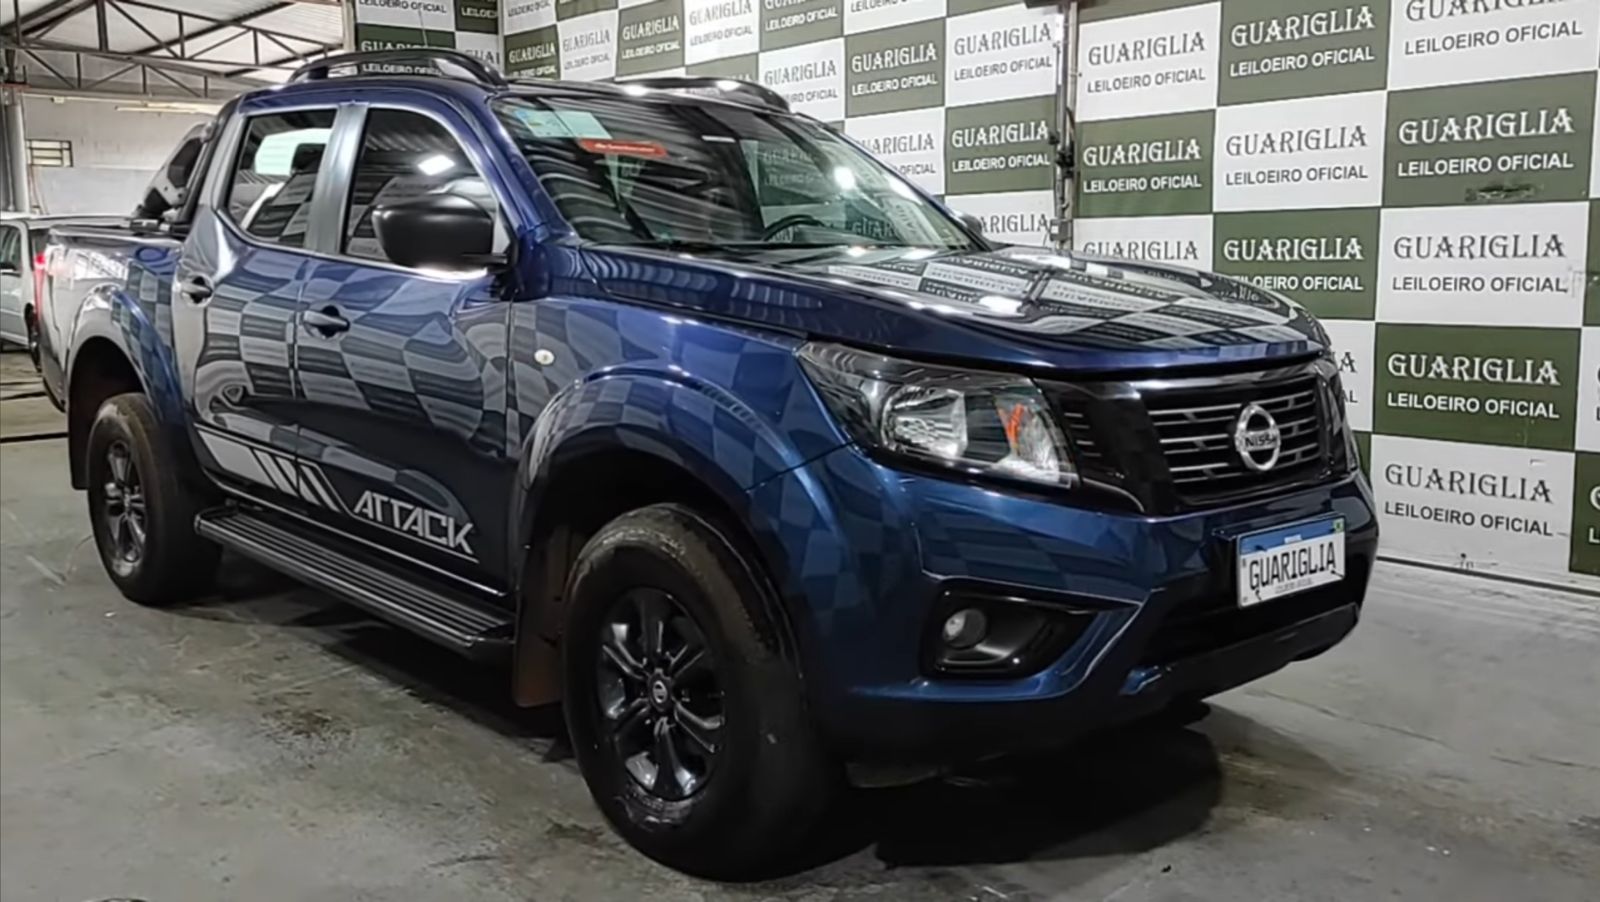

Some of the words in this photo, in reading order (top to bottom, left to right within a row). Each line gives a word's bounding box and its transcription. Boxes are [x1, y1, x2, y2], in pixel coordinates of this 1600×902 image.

[410, 1, 448, 13] OFICIAL
[689, 1, 752, 26] GUARIGLIA
[765, 14, 804, 32] LEILOEIRO
[806, 7, 838, 22] OFICIAL
[623, 15, 680, 41] GUARIGLIA
[690, 30, 723, 47] LEILOEIRO
[724, 26, 753, 39] OFICIAL
[954, 22, 1052, 56] GUARIGLIA
[1231, 5, 1376, 47] GUARIGLIA
[1405, 31, 1500, 55] LEILOEIRO
[1505, 20, 1583, 43] OFICIAL
[509, 43, 557, 64] GUARIGLIA
[563, 30, 611, 52] GUARIGLIA
[1088, 31, 1206, 66] GUARIGLIA
[852, 43, 938, 73] GUARIGLIA
[954, 62, 1008, 81] LEILOEIRO
[1010, 56, 1053, 74] OFICIAL
[1230, 54, 1308, 78] LEILOEIRO
[1311, 46, 1376, 68] OFICIAL
[764, 60, 837, 86] GUARIGLIA
[852, 78, 899, 97] LEILOEIRO
[901, 73, 938, 89] OFICIAL
[1087, 74, 1152, 94] LEILOEIRO
[1155, 68, 1207, 86] OFICIAL
[805, 88, 838, 102] OFICIAL
[952, 120, 1049, 148] GUARIGLIA
[1399, 107, 1576, 145] GUARIGLIA
[861, 132, 935, 155] UARIGLIA
[1083, 137, 1202, 168] GUARIGLIA
[1226, 125, 1369, 157] GUARIGLIA
[952, 156, 1006, 173] LEILOEIRO
[1008, 153, 1051, 169] OFICIAL
[1225, 169, 1302, 187] LEILOEIRO
[1306, 165, 1370, 182] OFICIAL
[1398, 157, 1493, 177] LEILOEIRO
[1497, 152, 1575, 172] OFICIAL
[1083, 177, 1148, 195] LEILOEIRO
[1150, 173, 1202, 191] OFICIAL
[1083, 240, 1200, 261] GUARIGLIA
[1223, 237, 1364, 261] GUARIGLIA
[1393, 234, 1567, 260] GUARIGLIA
[1302, 276, 1364, 292] OFICIAL
[1392, 277, 1485, 292] LEILOEIRO
[1490, 276, 1568, 293] OFICIAL
[1387, 353, 1561, 386] GUARIGLIA
[1387, 392, 1480, 413] LEILOEIRO
[1485, 398, 1560, 419] OFICIAL
[1385, 463, 1554, 504] GUARIGLIA
[354, 490, 474, 555] ATTACK
[1384, 501, 1475, 527] LEILOEIRO
[1480, 514, 1554, 537] OFICIAL
[1249, 541, 1337, 591] GUARIGLIA
